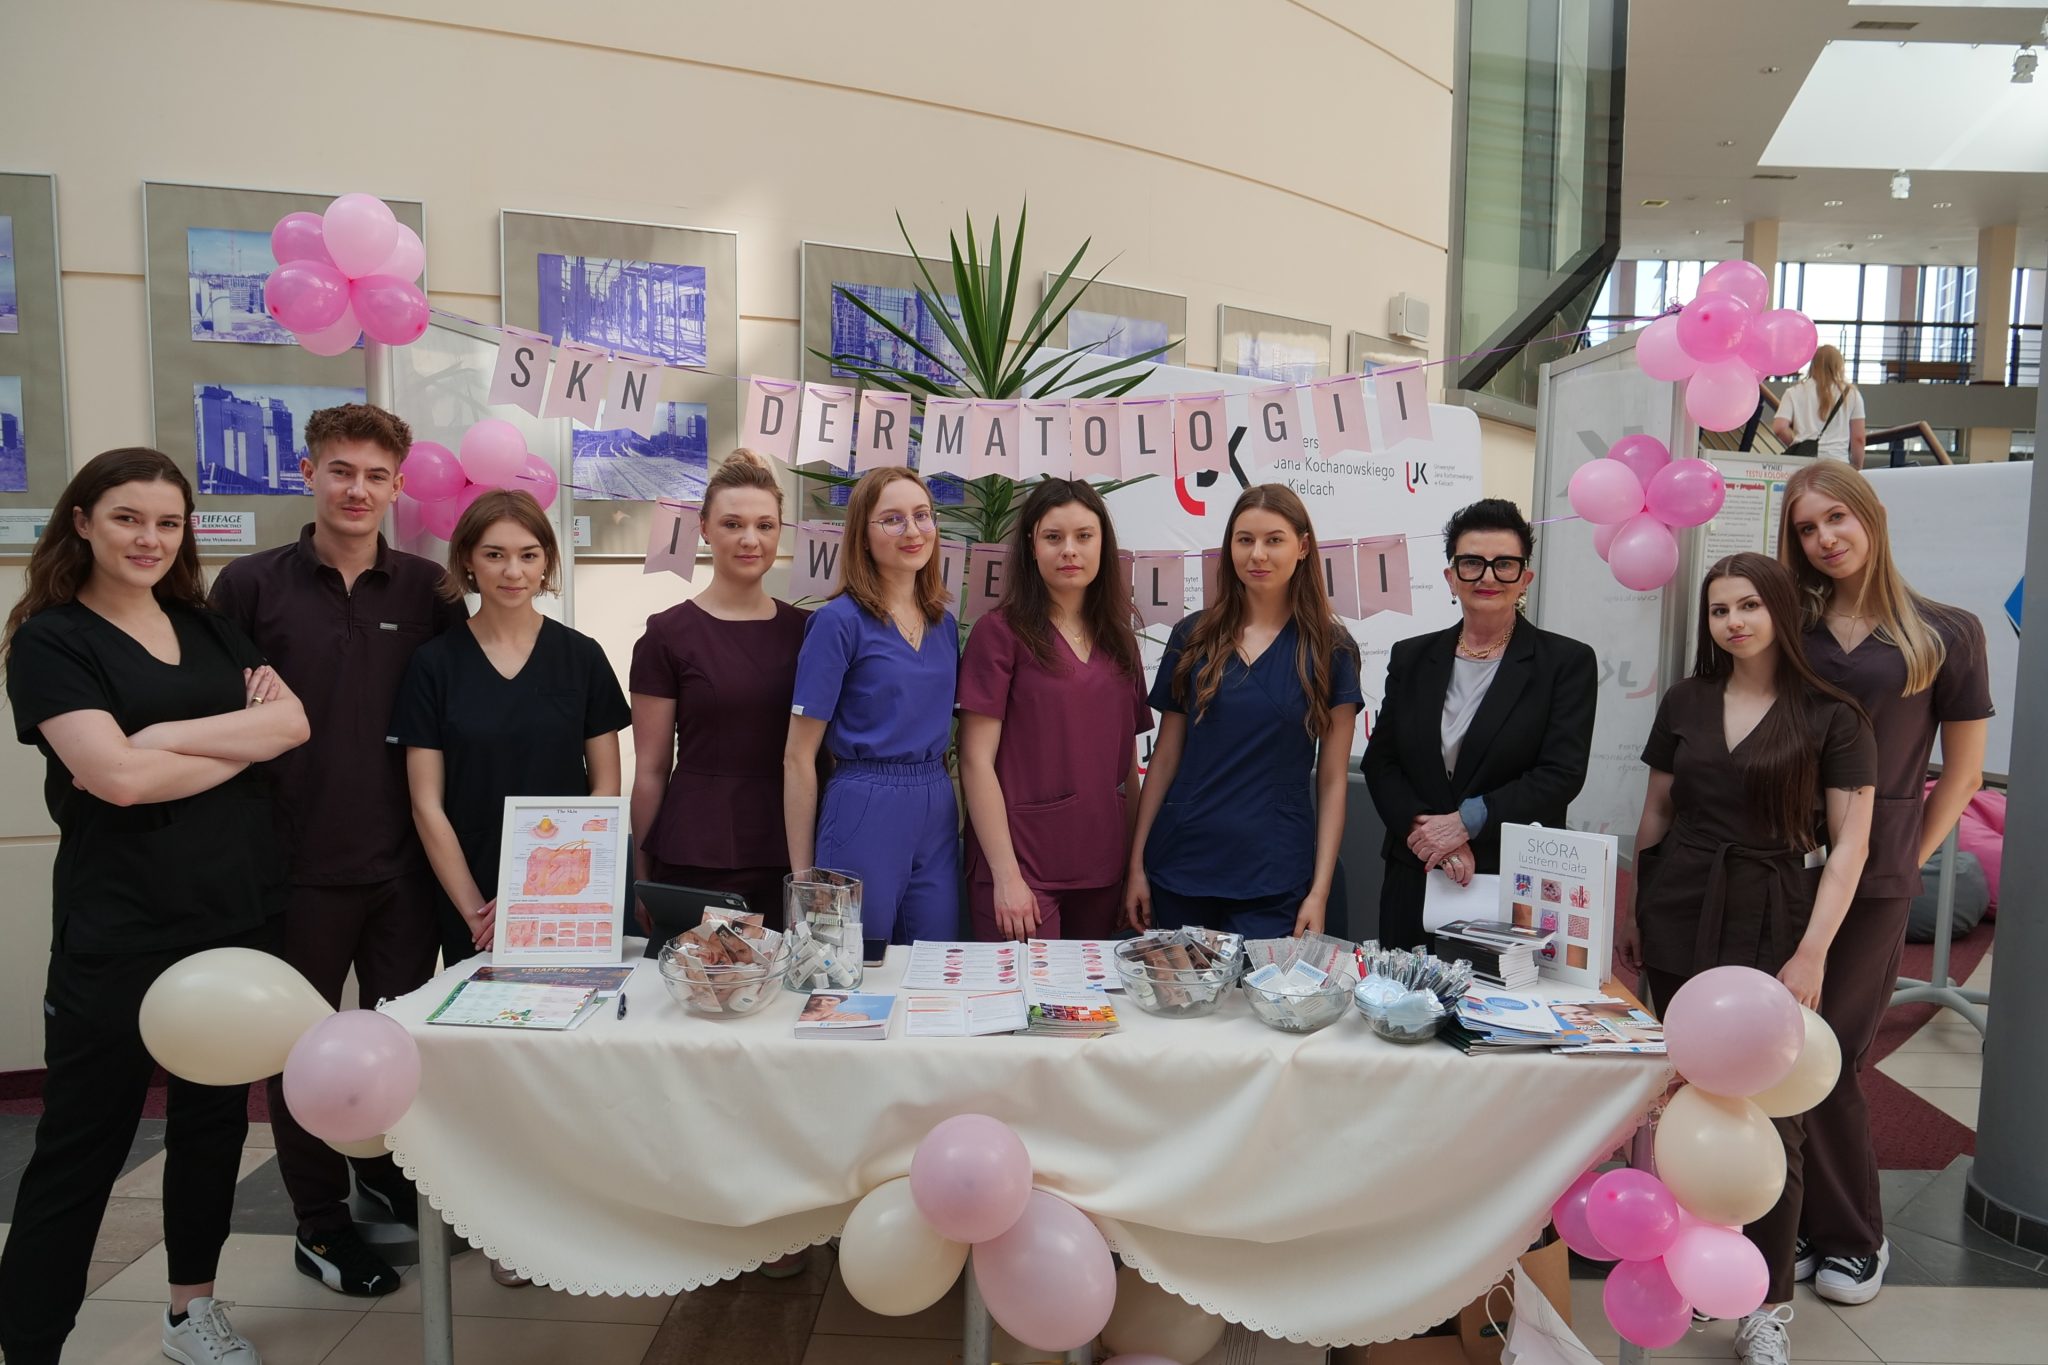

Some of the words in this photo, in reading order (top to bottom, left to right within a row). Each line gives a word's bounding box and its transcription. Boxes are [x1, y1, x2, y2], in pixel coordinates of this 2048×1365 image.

[510, 347, 648, 413] SKN
[760, 380, 1410, 457] DERMATOLOGII
[1305, 457, 1395, 481] Kochanowskiego
[1288, 479, 1335, 496] Kielcach
[201, 514, 242, 523] EIFFAGE
[1527, 838, 1579, 860] SKÓRA
[1519, 851, 1558, 869] lustrem
